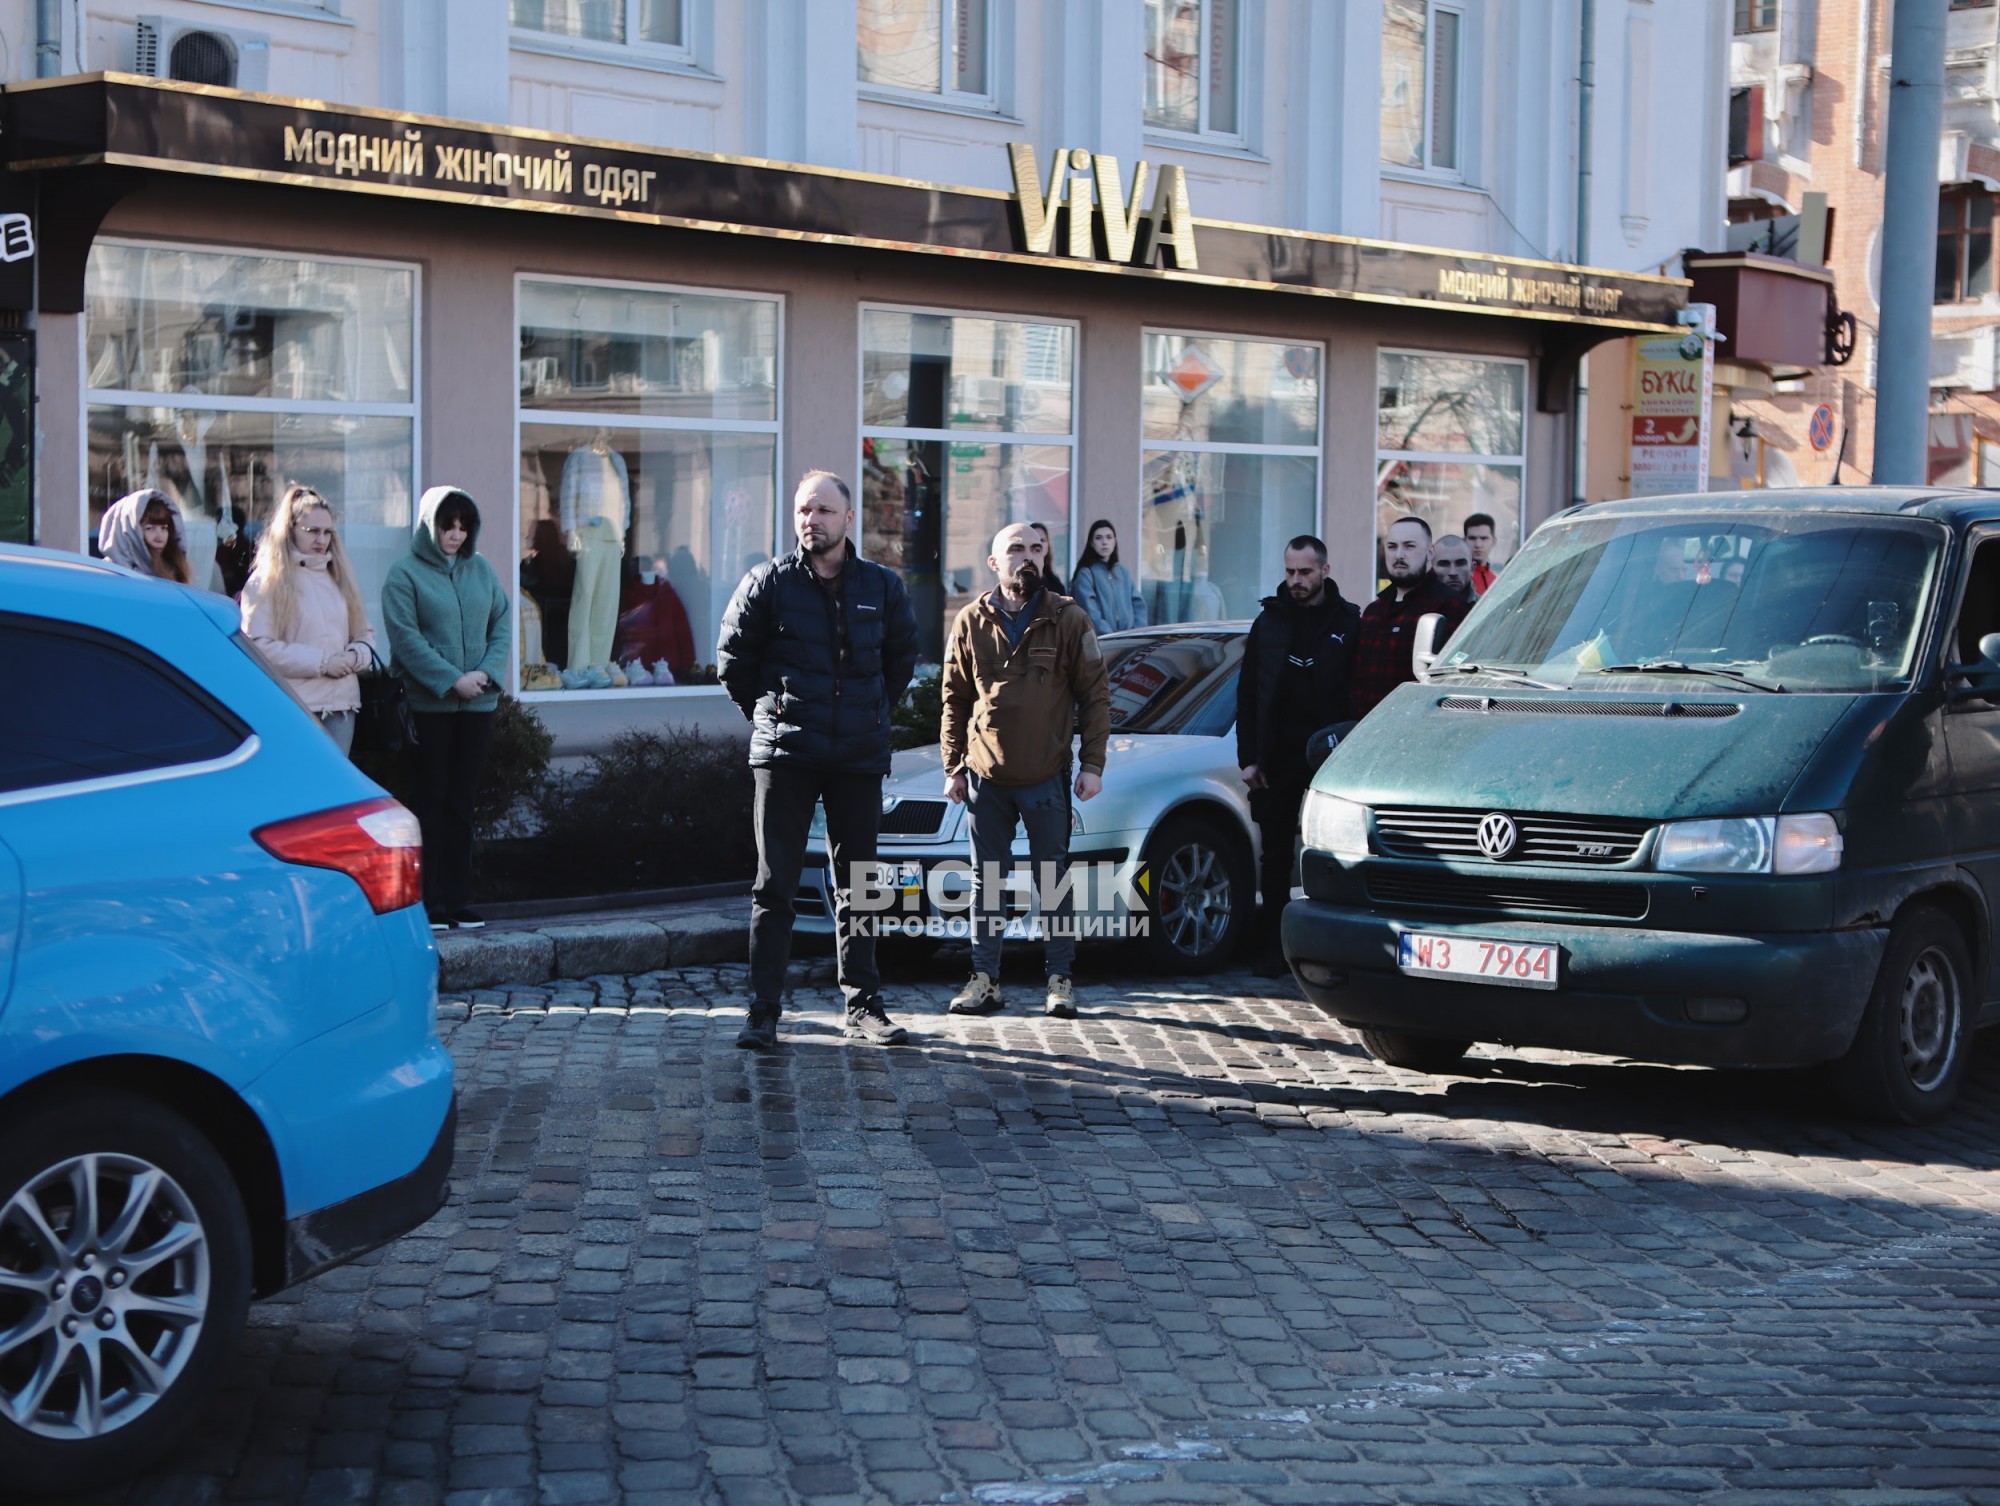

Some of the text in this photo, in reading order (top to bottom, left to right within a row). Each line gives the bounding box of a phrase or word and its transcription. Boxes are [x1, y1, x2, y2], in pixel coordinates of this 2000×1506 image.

[284, 125, 657, 206] МОДНИЙ ЖІНОЧИЙ ОДЯГ
[1439, 268, 1623, 315] МОДНИЙ ЖІНОЧИЙ ОДЯГ
[1641, 369, 1697, 395] БУКИ
[1644, 419, 1655, 434] 2
[1577, 845, 1613, 856] TDI
[1418, 937, 1450, 969] W3
[1479, 943, 1550, 979] 7964
